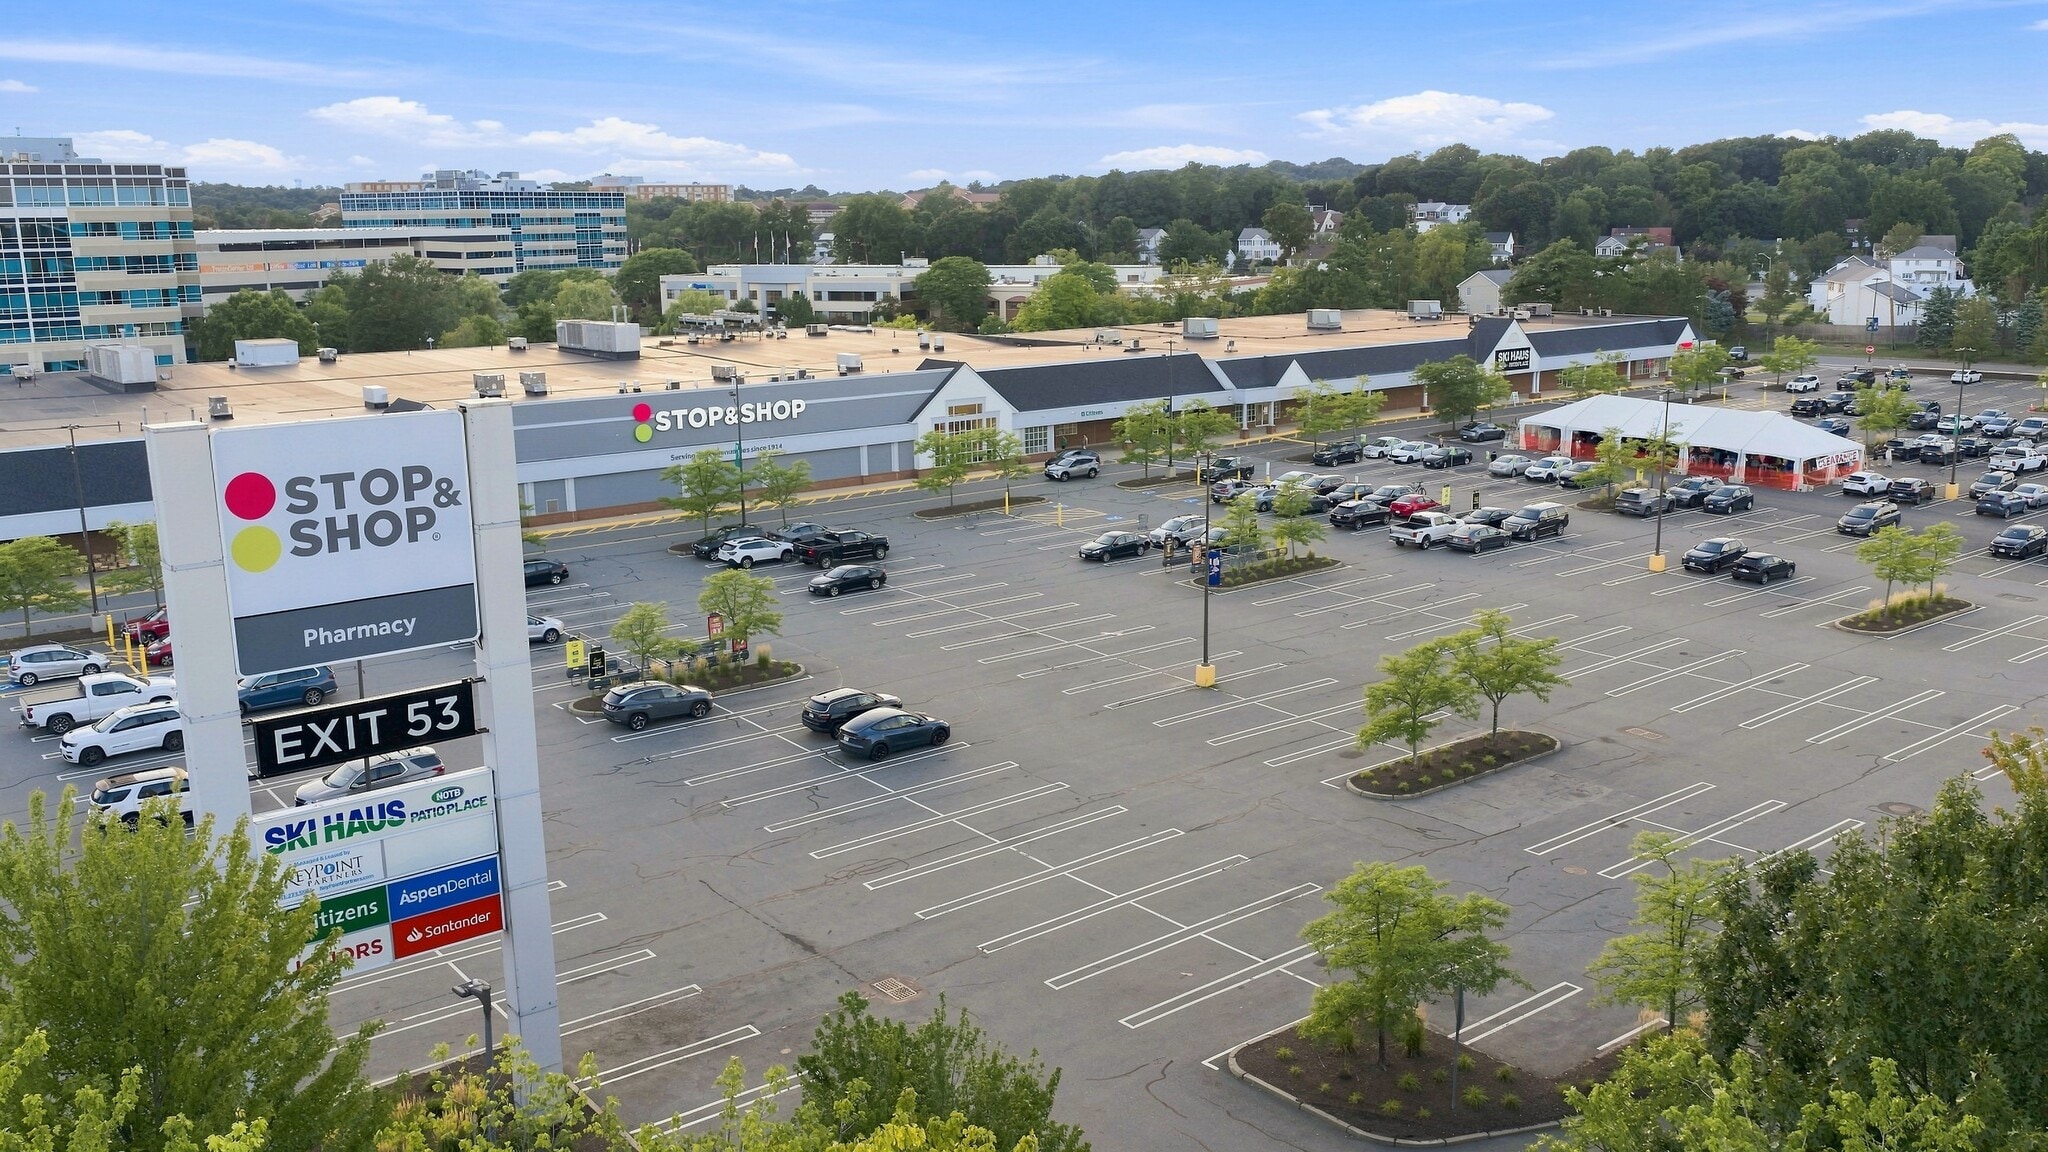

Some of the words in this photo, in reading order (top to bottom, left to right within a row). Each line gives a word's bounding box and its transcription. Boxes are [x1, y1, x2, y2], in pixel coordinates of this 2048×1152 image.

[1498, 352, 1510, 361] SKI
[1511, 350, 1529, 361] HAUS
[655, 399, 806, 432] STOP&SHOP
[767, 443, 783, 451] 1914
[1818, 452, 1857, 468] CLEARANCE
[289, 506, 436, 557] SHOP
[303, 617, 416, 647] Pharmacy
[273, 709, 388, 765] EXIT
[406, 695, 460, 737] 53
[410, 805, 445, 823] PATIO
[446, 796, 488, 815] PLACE
[264, 818, 318, 855] SKI
[323, 799, 407, 843] HAUS
[307, 869, 363, 887] PARTNERS
[400, 869, 492, 906] AspenDental
[313, 901, 379, 929] itizens
[425, 912, 491, 938] Santander
